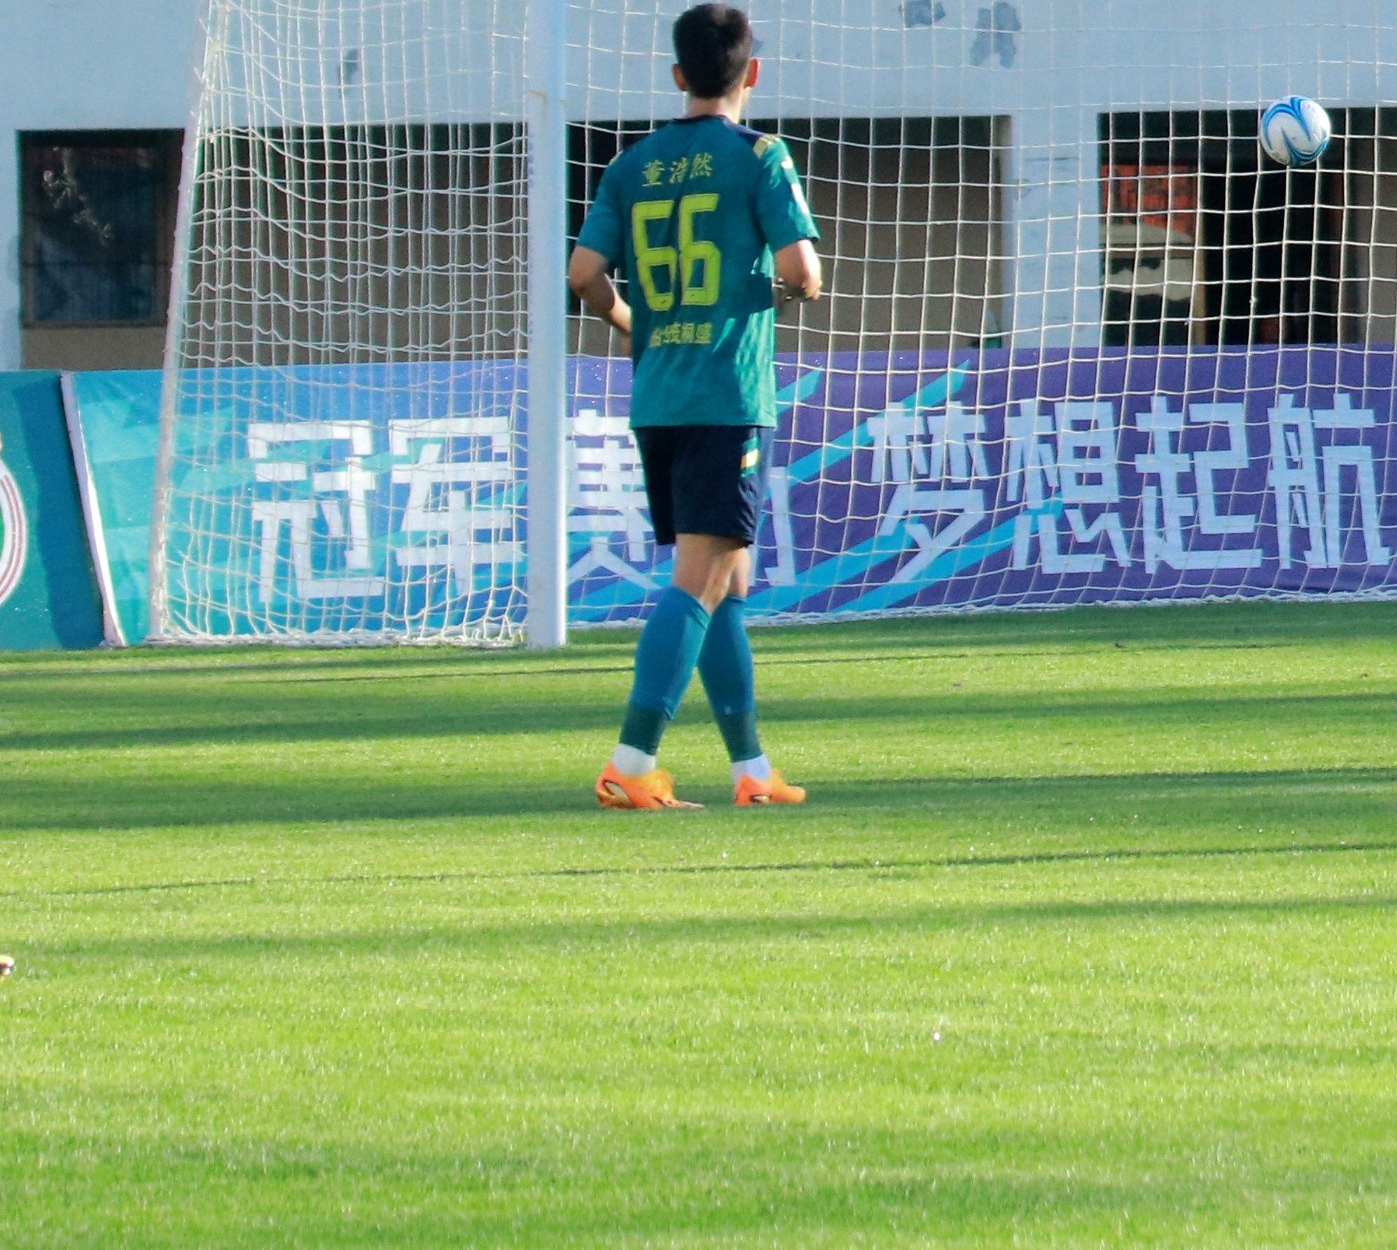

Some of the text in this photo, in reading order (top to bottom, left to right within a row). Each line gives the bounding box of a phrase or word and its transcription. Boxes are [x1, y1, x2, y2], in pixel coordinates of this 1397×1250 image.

[631, 193, 721, 312] 66
[247, 392, 1391, 603] 冠军赛 梦想起航
